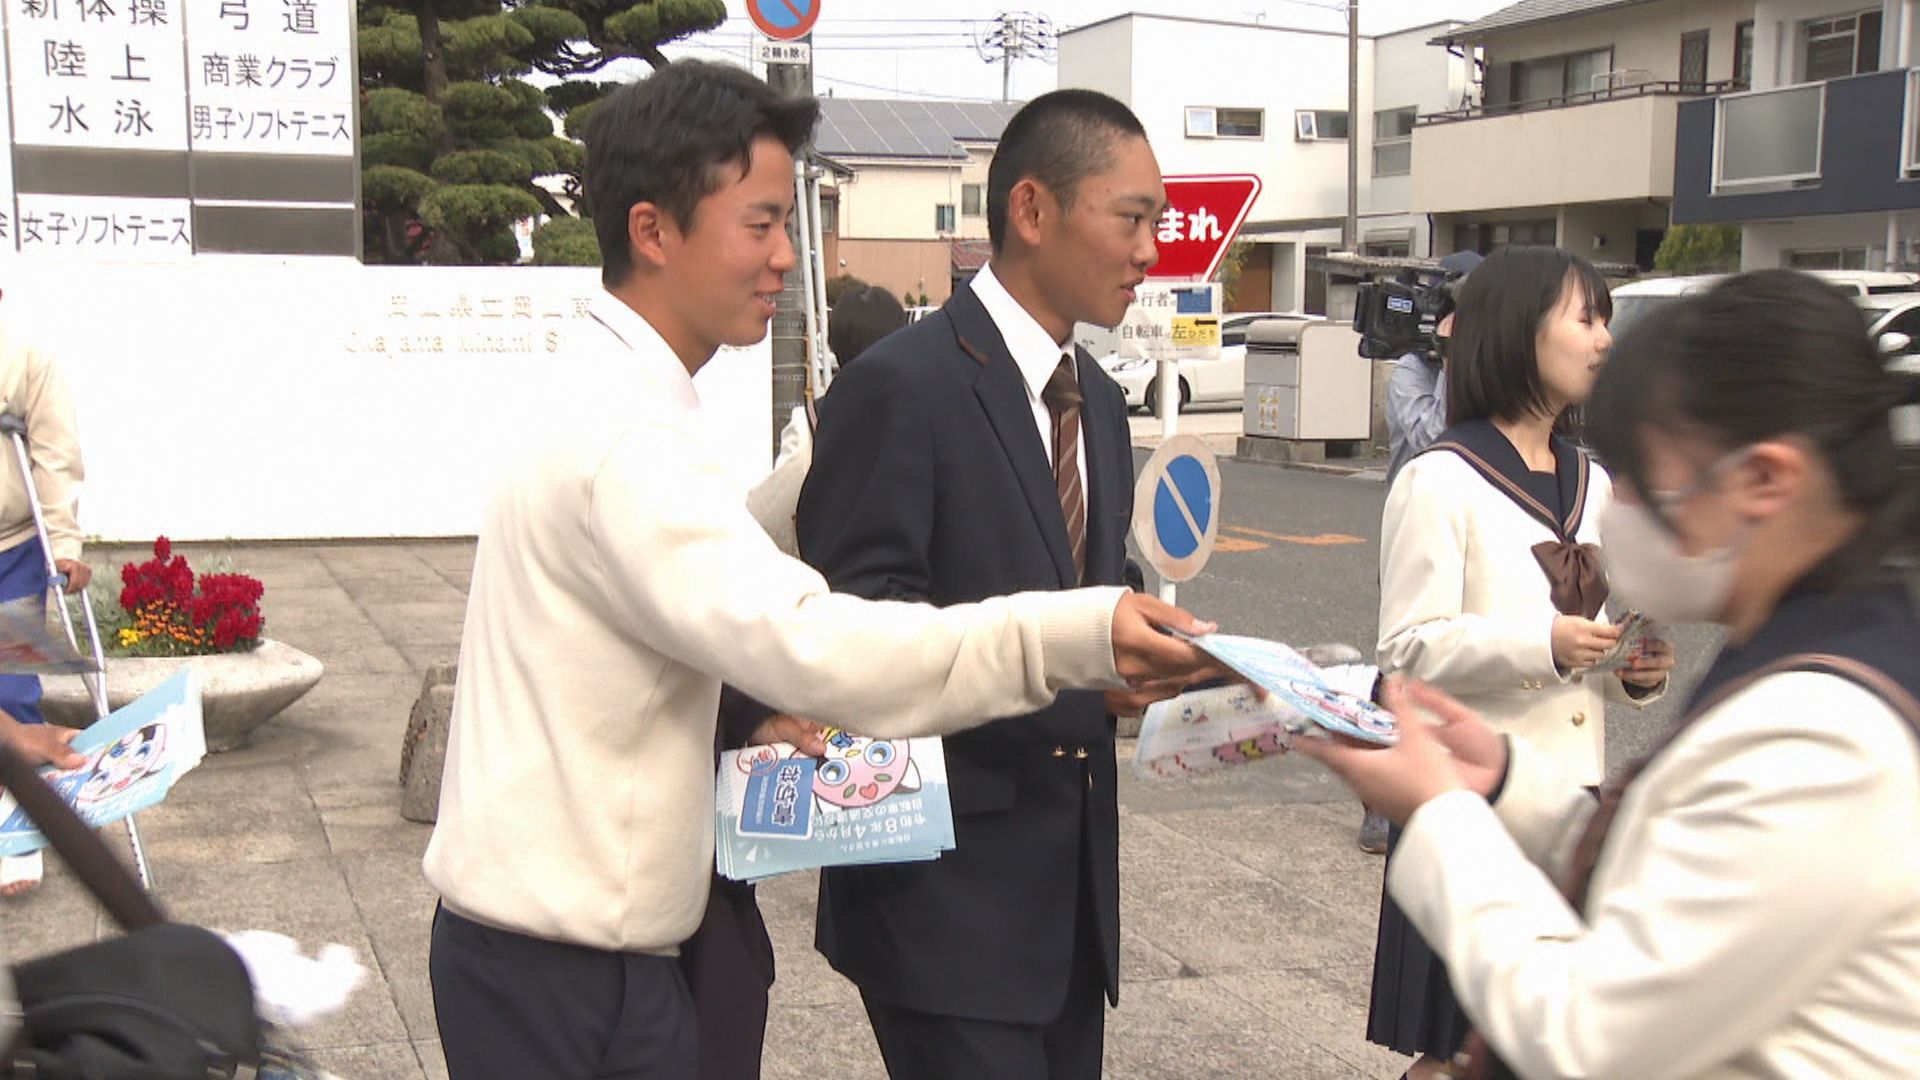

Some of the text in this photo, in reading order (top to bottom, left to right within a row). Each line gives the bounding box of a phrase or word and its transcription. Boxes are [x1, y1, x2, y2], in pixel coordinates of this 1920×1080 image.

[219, 0, 319, 34] 弓道
[44, 39, 150, 82] 陸上
[202, 53, 339, 89] 商業クラブ
[49, 96, 153, 136] 水泳
[193, 105, 350, 141] 男子ソフトテニス
[21, 211, 190, 245] 女子ソフトテニス
[1152, 206, 1223, 243] まれ
